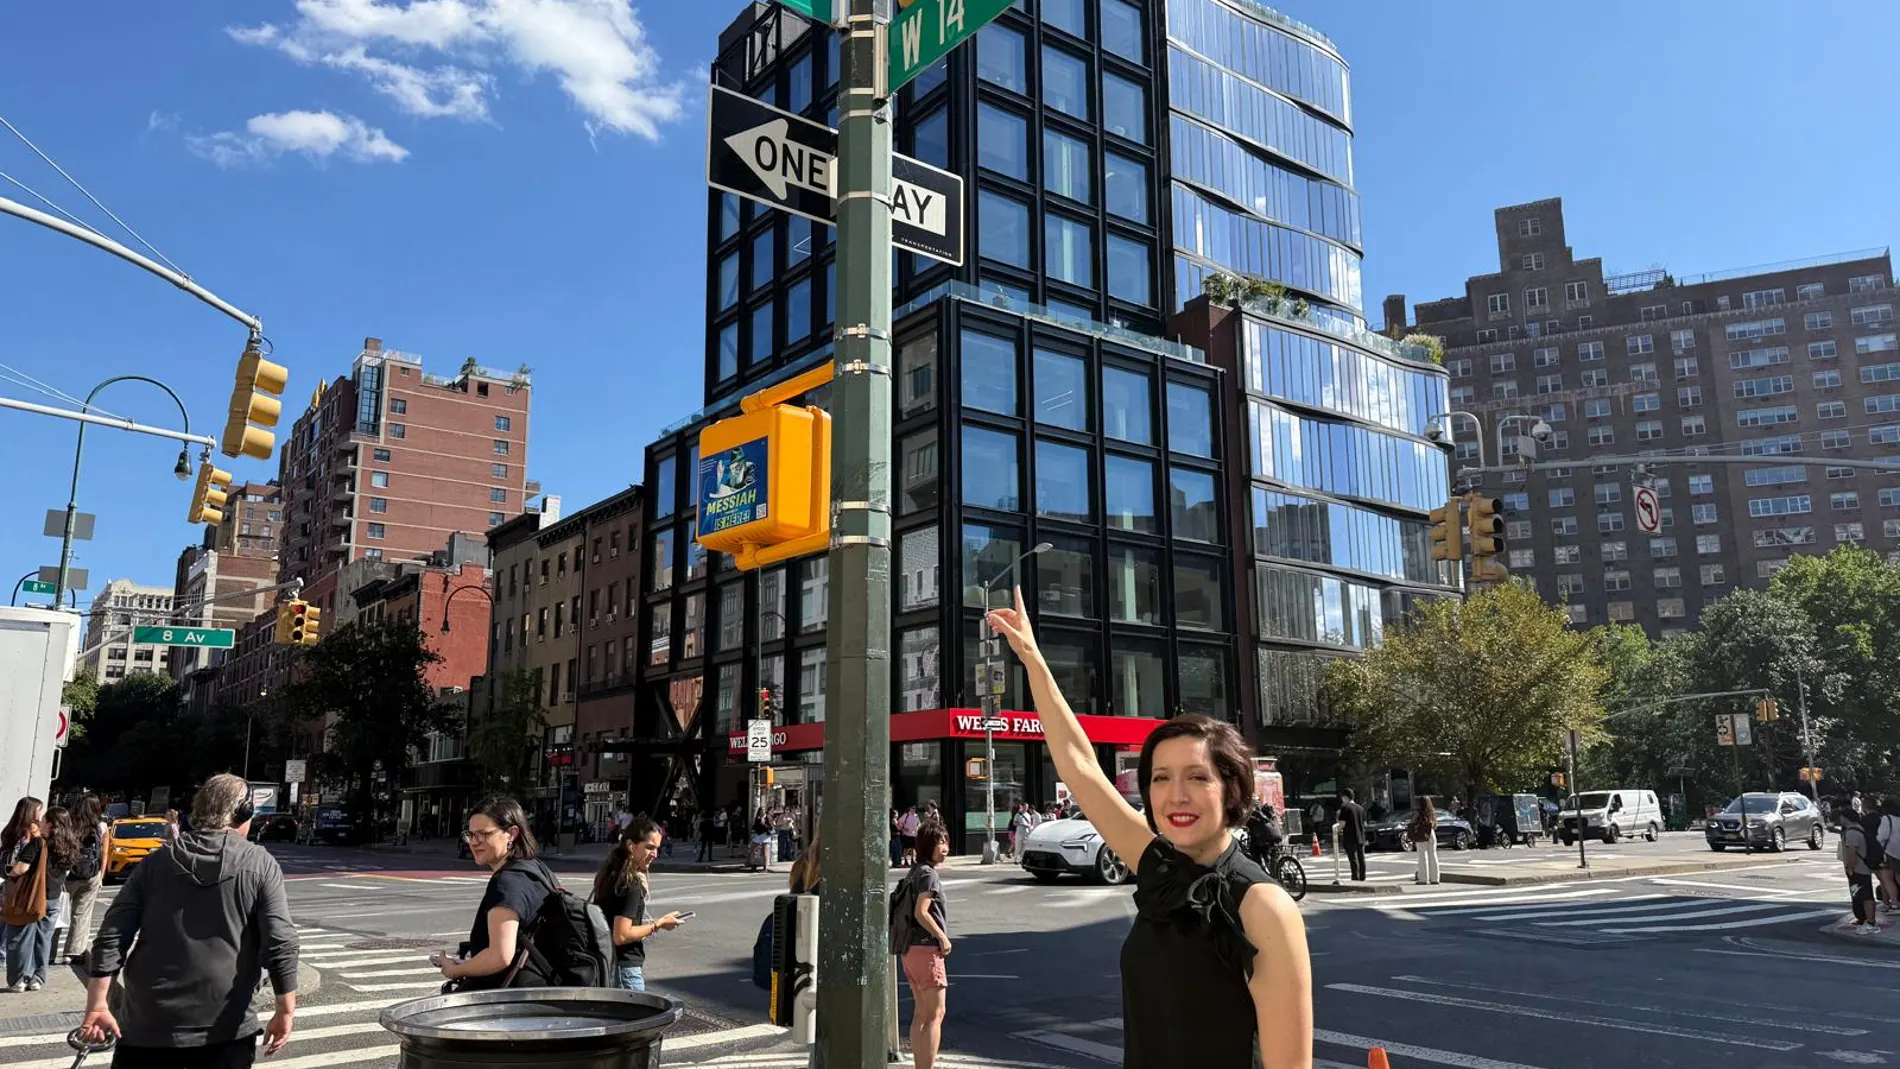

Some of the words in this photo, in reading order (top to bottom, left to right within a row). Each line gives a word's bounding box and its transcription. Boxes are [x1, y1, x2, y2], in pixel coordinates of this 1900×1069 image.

[902, 8, 922, 71] W
[939, 0, 964, 45] 14
[755, 135, 827, 191] ONE
[892, 184, 932, 225] AY
[706, 488, 757, 516] MESSIAH
[714, 517, 724, 532] IS
[724, 509, 751, 529] HERE!
[162, 630, 173, 641] 8
[184, 631, 206, 643] Av
[957, 715, 1009, 732] WES
[1013, 718, 1045, 733] FAR
[751, 736, 768, 748] 25
